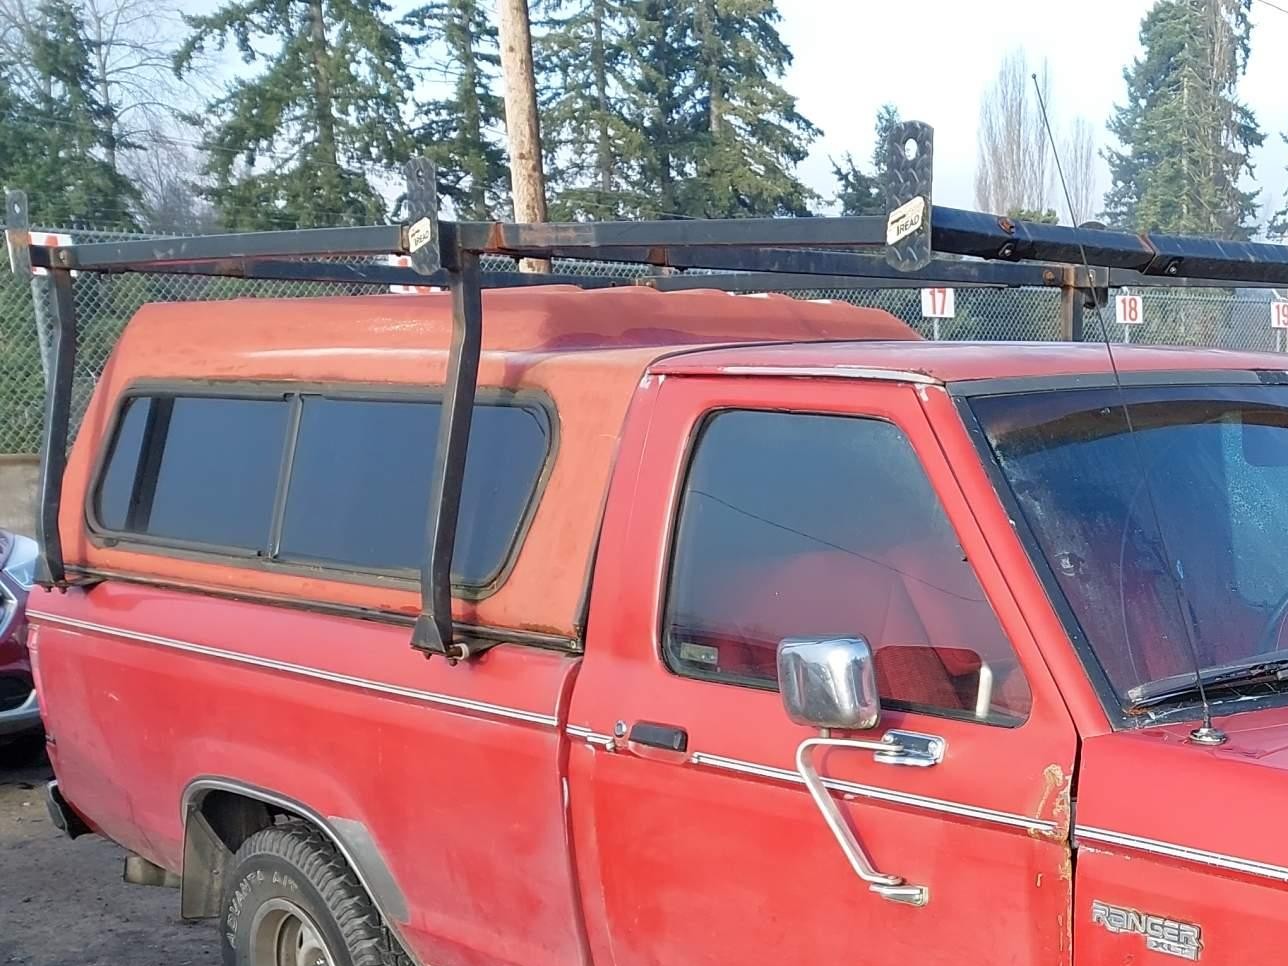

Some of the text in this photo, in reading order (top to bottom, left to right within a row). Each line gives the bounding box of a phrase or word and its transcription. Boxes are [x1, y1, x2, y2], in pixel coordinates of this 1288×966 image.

[928, 288, 947, 315] 17
[1121, 296, 1138, 322] 18
[1092, 900, 1203, 949] RANGER
[1150, 940, 1188, 955] XLT
